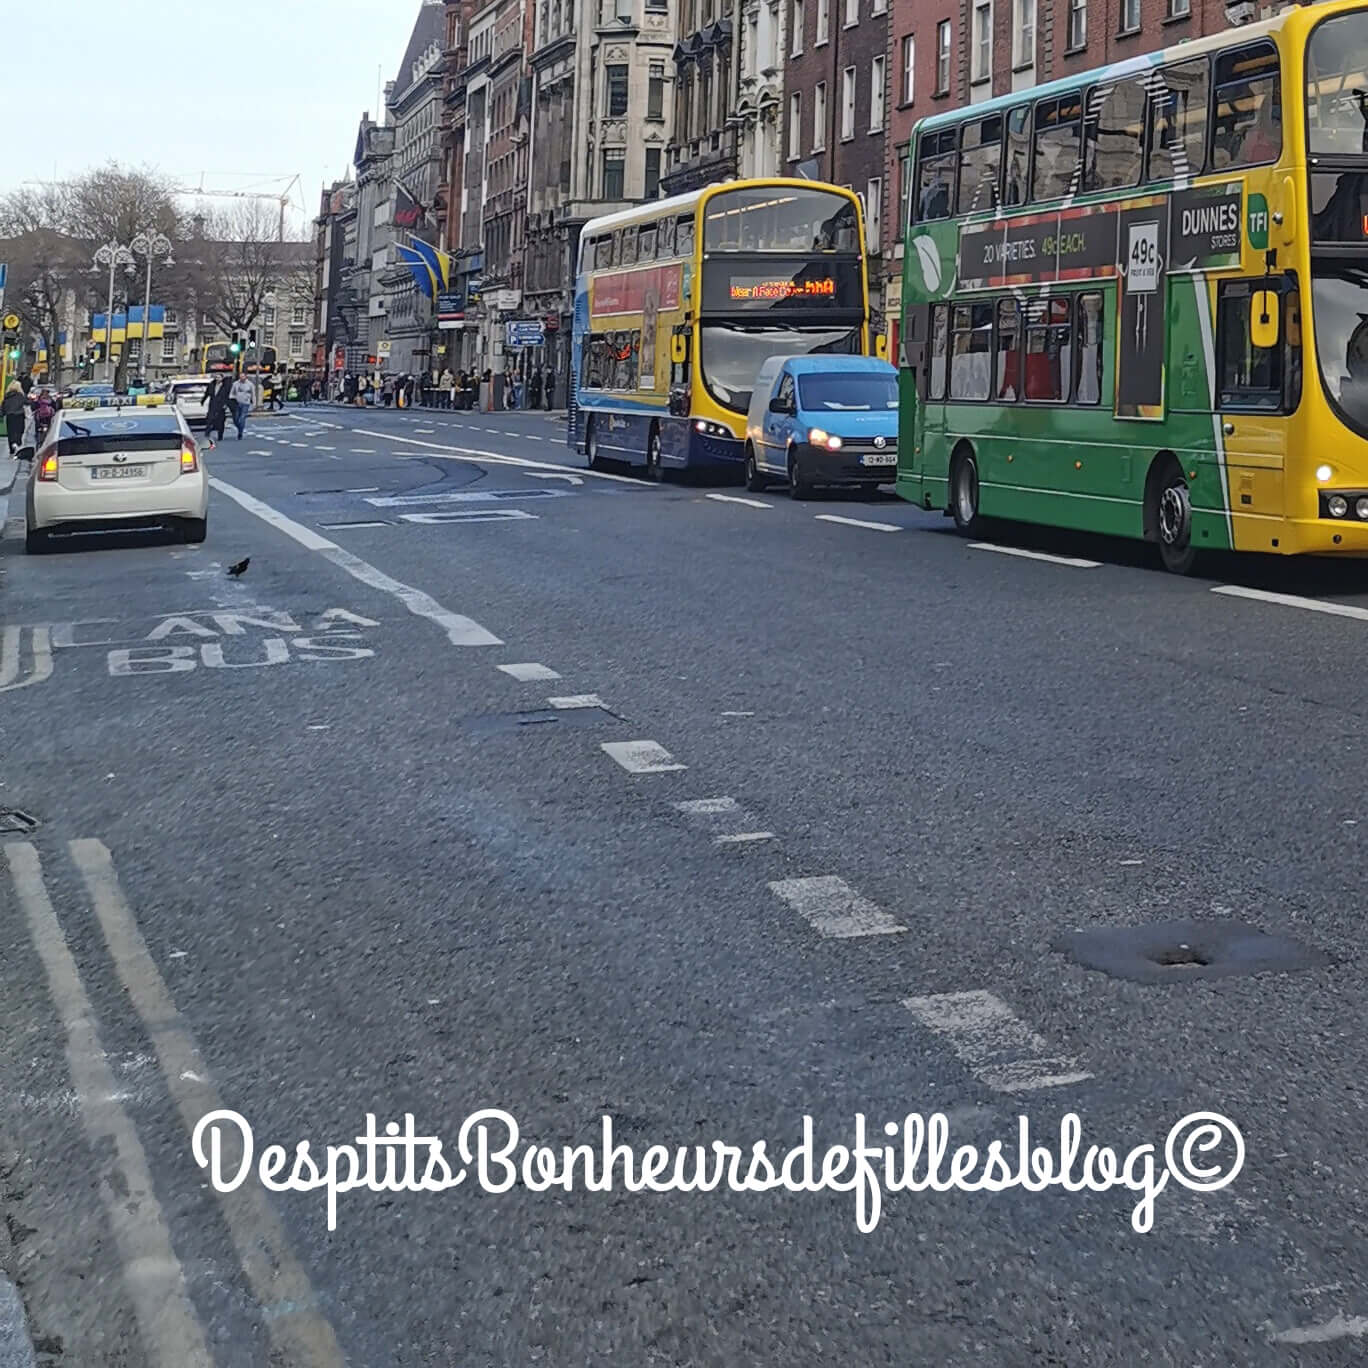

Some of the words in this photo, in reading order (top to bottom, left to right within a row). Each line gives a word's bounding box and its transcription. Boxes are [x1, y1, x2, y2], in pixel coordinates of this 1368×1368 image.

[1182, 203, 1238, 236] DUNNES
[1250, 212, 1268, 233] TFI
[1131, 237, 1155, 264] 49c
[1211, 233, 1236, 249] STORES
[984, 244, 995, 264] 20
[731, 286, 752, 297] Wear
[107, 634, 375, 676] BUS
